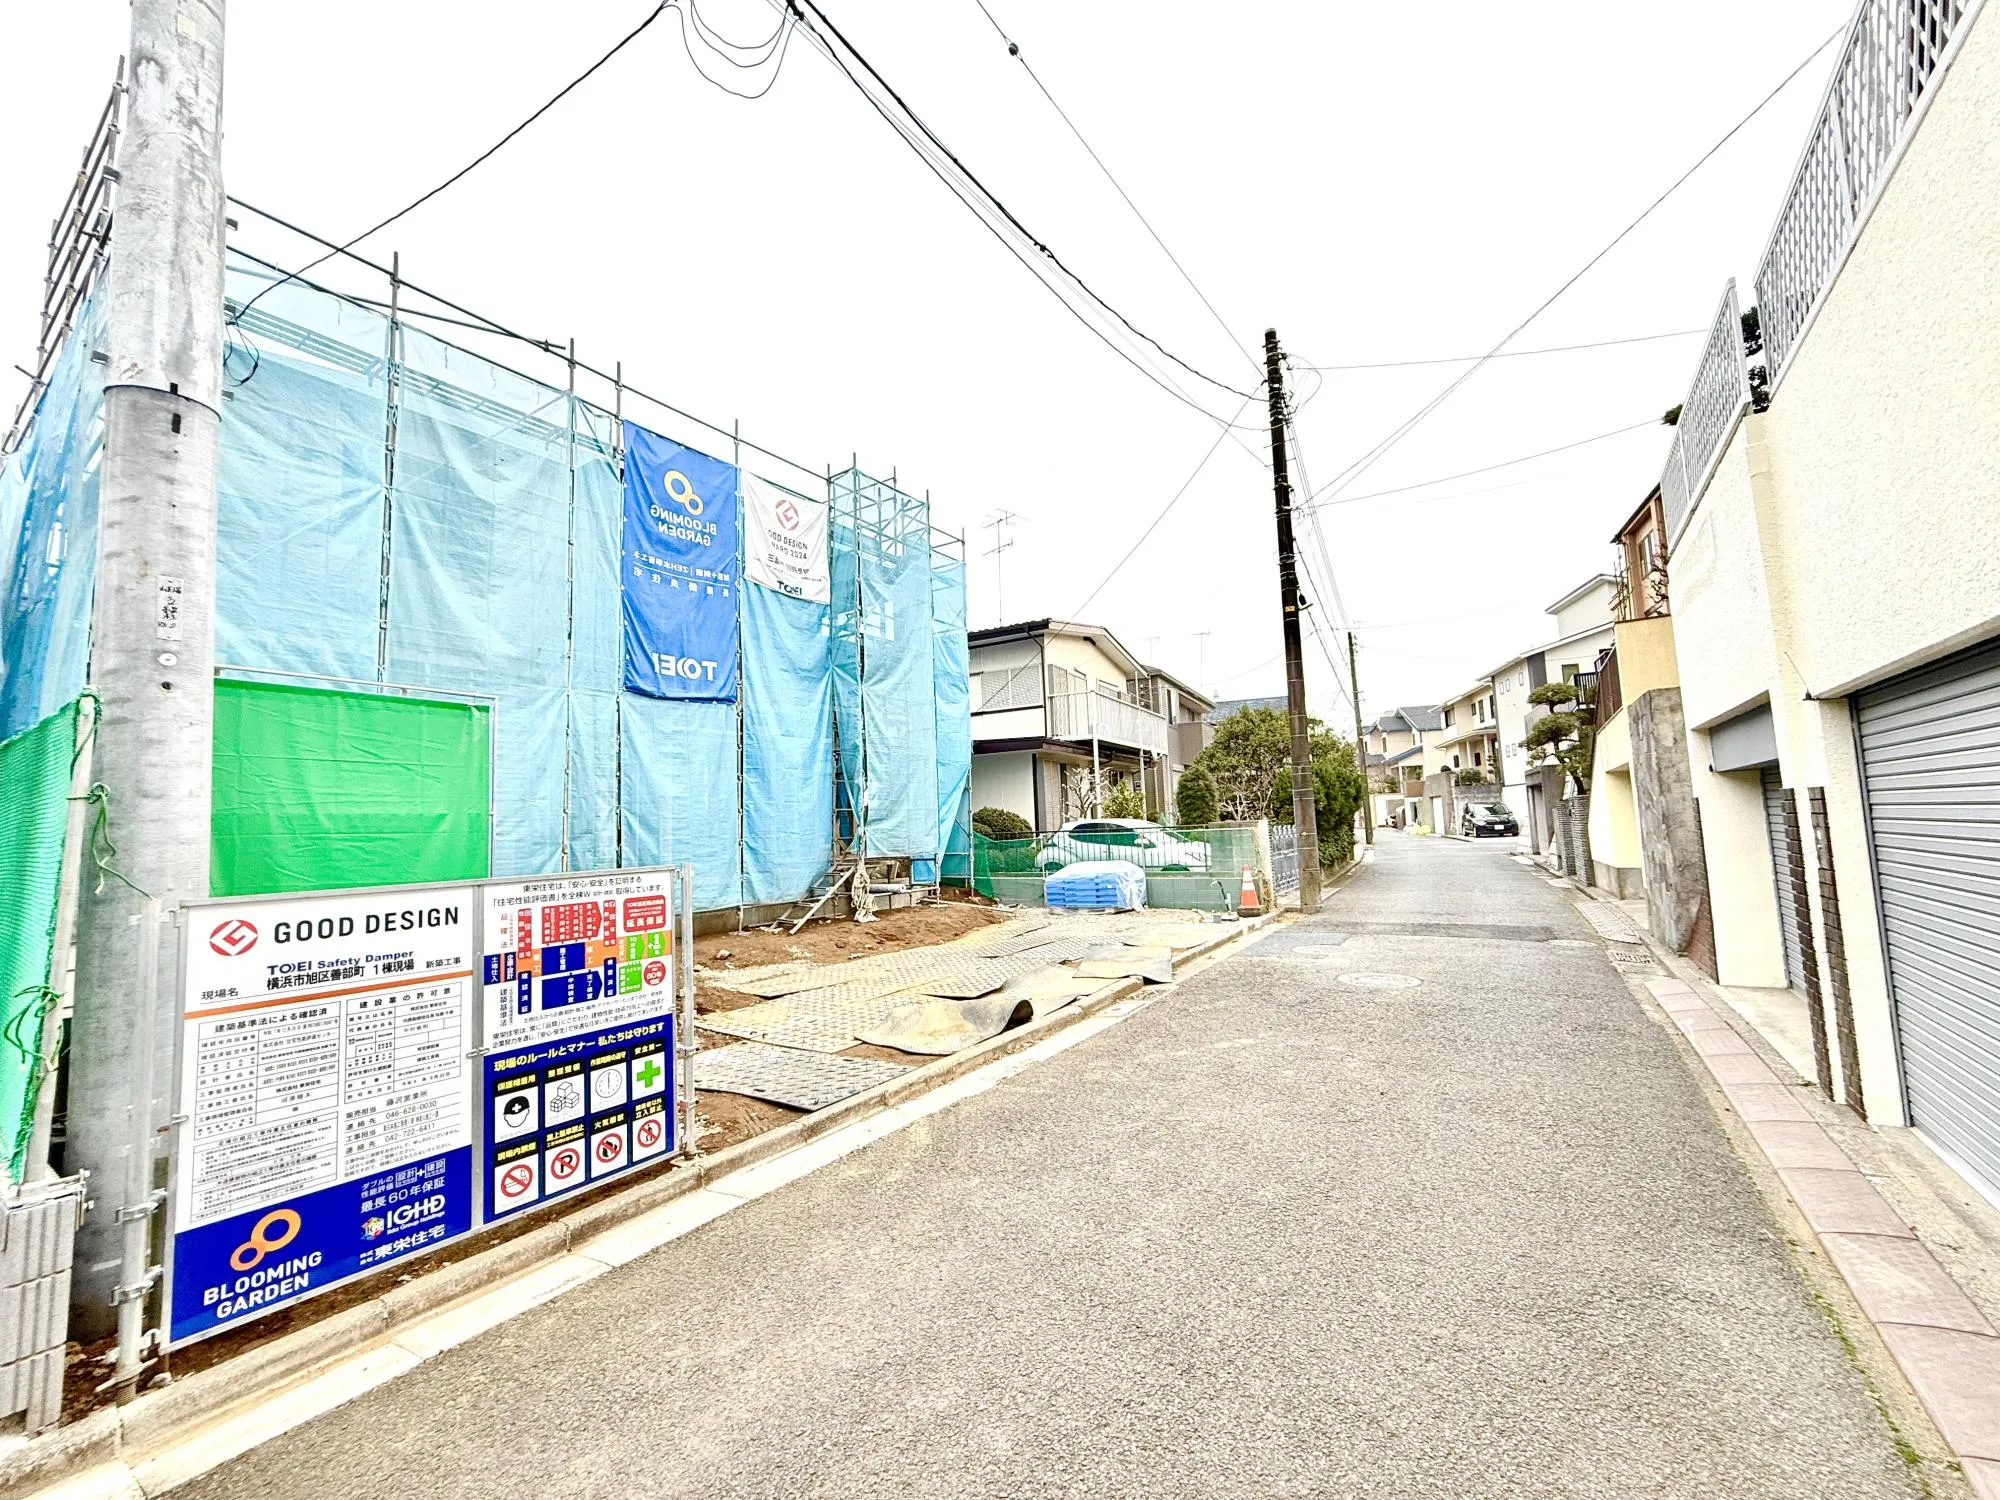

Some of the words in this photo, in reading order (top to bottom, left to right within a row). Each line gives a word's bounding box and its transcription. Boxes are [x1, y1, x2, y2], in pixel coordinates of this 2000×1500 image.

[784, 537, 808, 550] DESIGN
[274, 917, 354, 944] GOOD
[366, 906, 458, 935] DESIGN
[318, 957, 361, 970] Safety
[366, 950, 414, 965] Damper
[426, 957, 461, 969] 新築工事
[490, 955, 498, 982] 土地仕入
[266, 965, 365, 991] 横浜市旭区善部町
[374, 959, 415, 976] 1棟現場
[202, 988, 239, 1001] 現場名
[359, 987, 450, 1008] 建設業の許可票
[499, 988, 507, 1026] 建築基準法
[214, 1007, 327, 1033] 建築基準法による確認済
[494, 1038, 595, 1072] 現場のルールとマナー
[597, 1021, 664, 1047] 私たちは守ります
[634, 1041, 661, 1055] 安全第一
[385, 1100, 436, 1119] 046-628-0030
[635, 1103, 661, 1119] 立入禁止
[361, 1174, 393, 1191] ダブルの
[397, 1168, 415, 1181] 設計
[360, 1181, 393, 1199] 性能評価
[360, 1175, 445, 1214] 最長60年保証
[374, 1223, 444, 1261] 東栄住宅
[203, 1251, 322, 1307] BLOOMING
[216, 1272, 309, 1319] GARDEN
